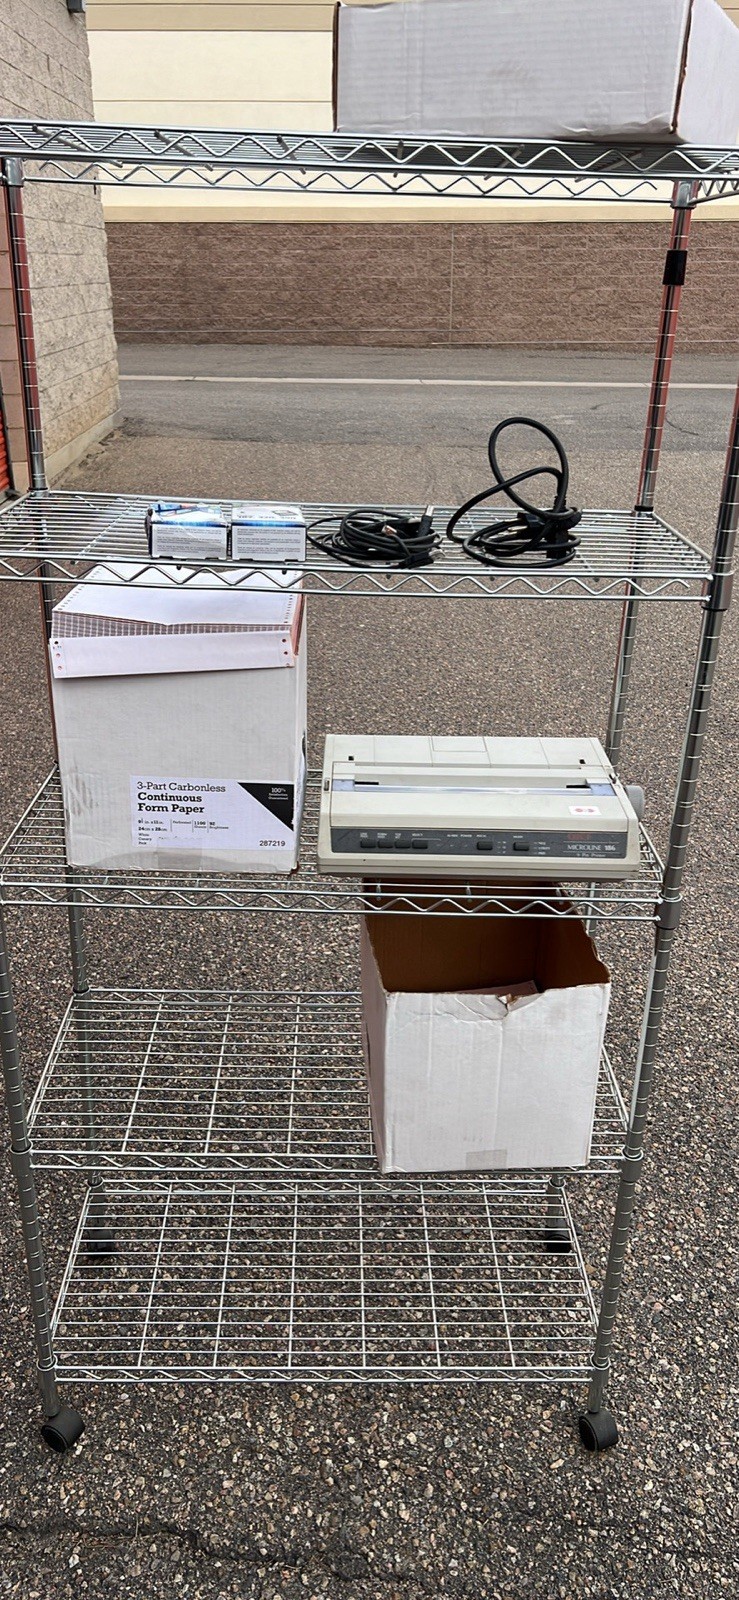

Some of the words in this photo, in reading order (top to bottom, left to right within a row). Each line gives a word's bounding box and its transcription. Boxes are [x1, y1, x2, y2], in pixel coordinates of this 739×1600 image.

[137, 781, 167, 791] 3-Part
[168, 782, 226, 792] Carbonless
[137, 791, 202, 803] Continuous
[137, 802, 168, 812] Form
[171, 803, 205, 815] Paper
